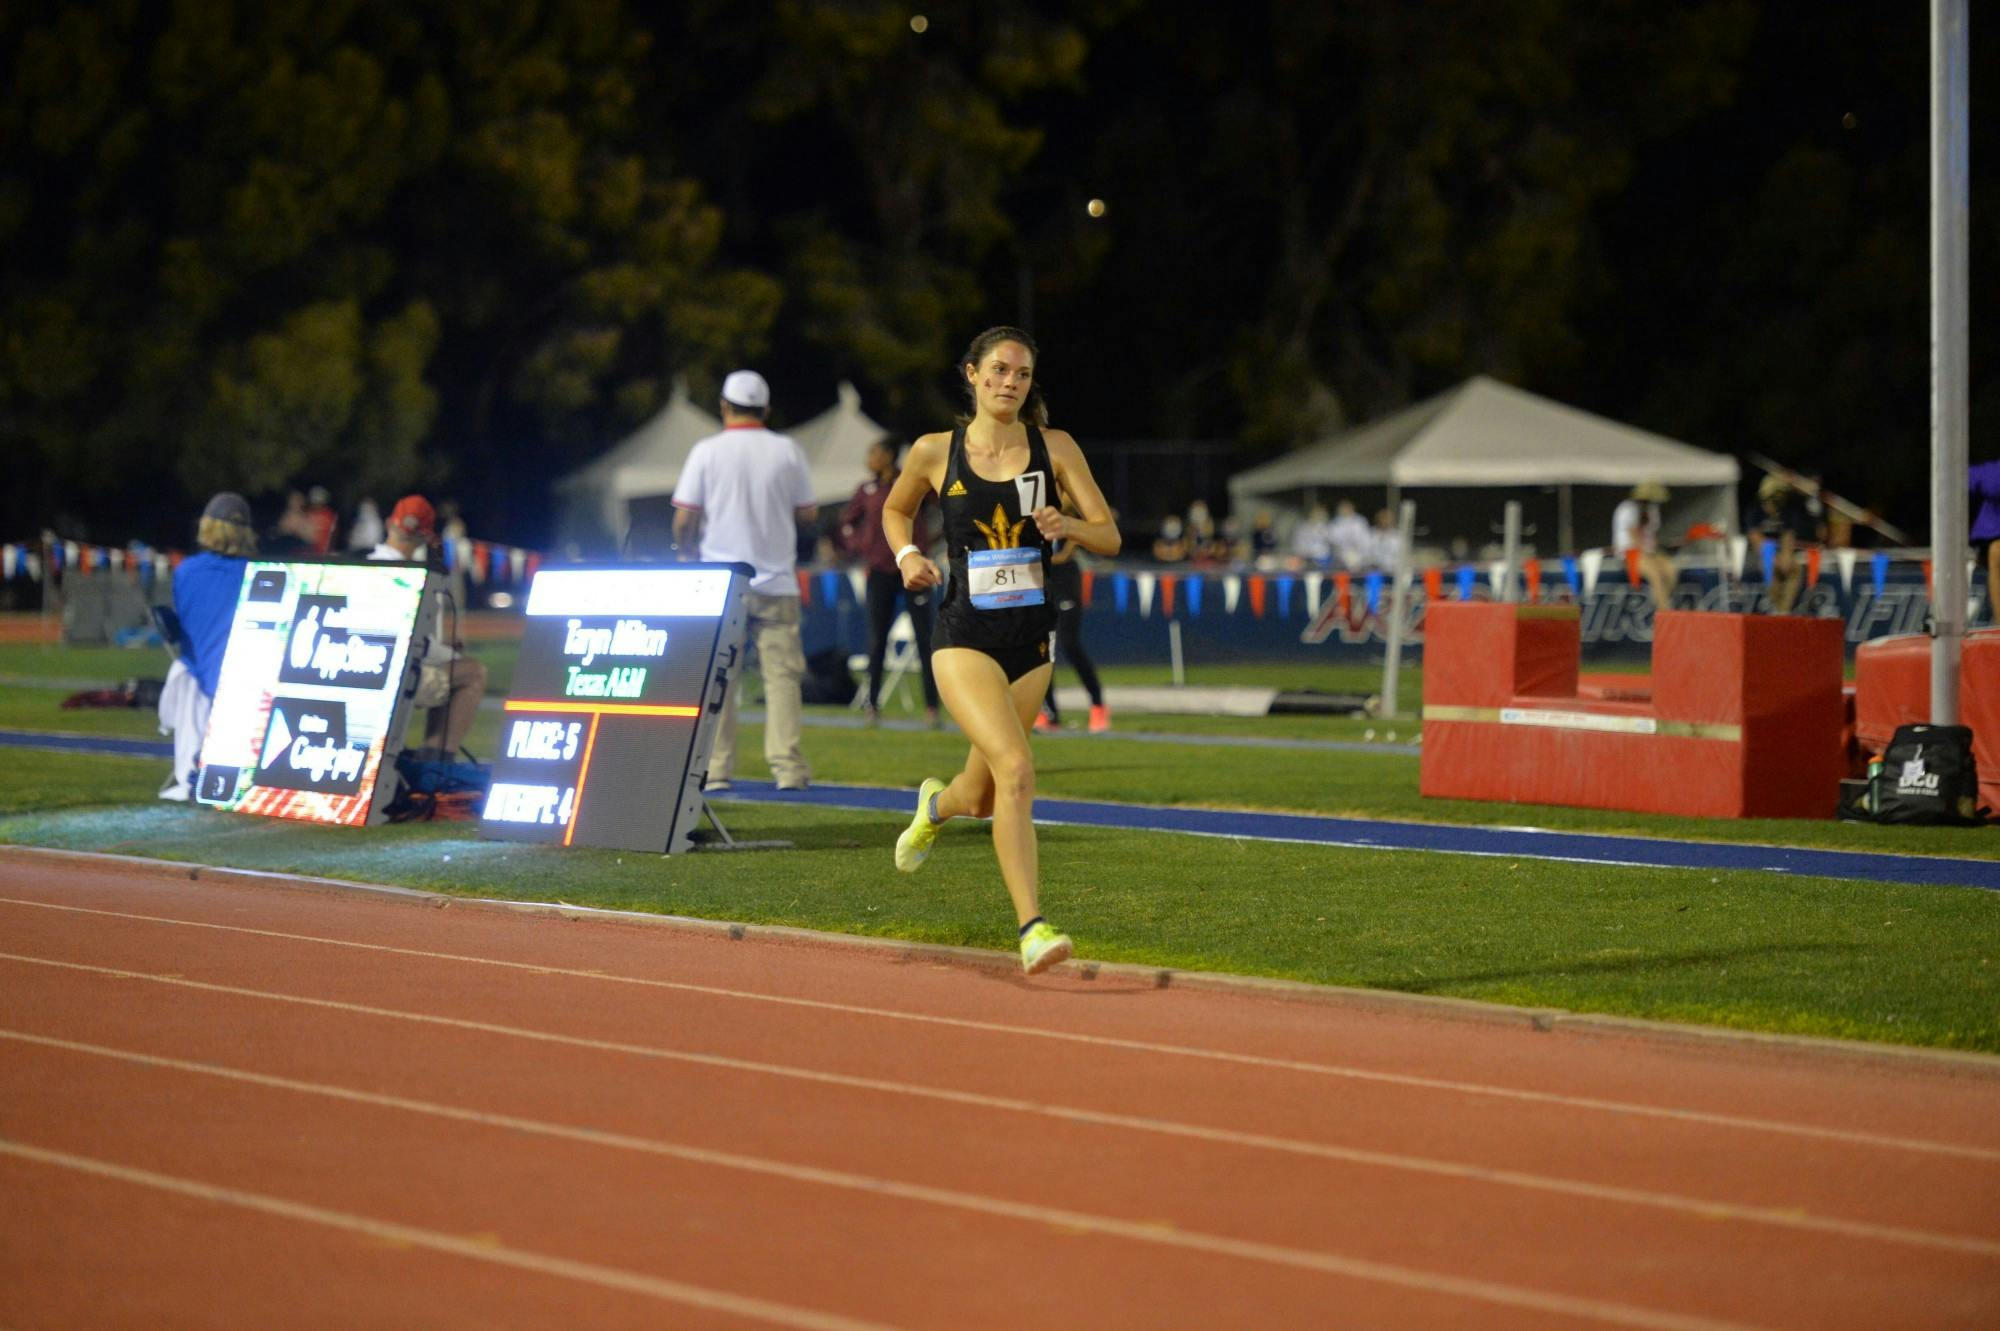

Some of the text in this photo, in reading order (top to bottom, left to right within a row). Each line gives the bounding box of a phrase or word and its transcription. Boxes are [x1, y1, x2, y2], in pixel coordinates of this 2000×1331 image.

[947, 489, 968, 497] adidas
[1022, 476, 1040, 513] 7
[995, 568, 1017, 586] 81
[312, 633, 388, 680] App Store
[564, 619, 612, 666] Taryn
[565, 666, 648, 698] Texas A&M
[289, 734, 338, 783] Google
[562, 722, 582, 761] 5
[557, 786, 575, 825] 4
